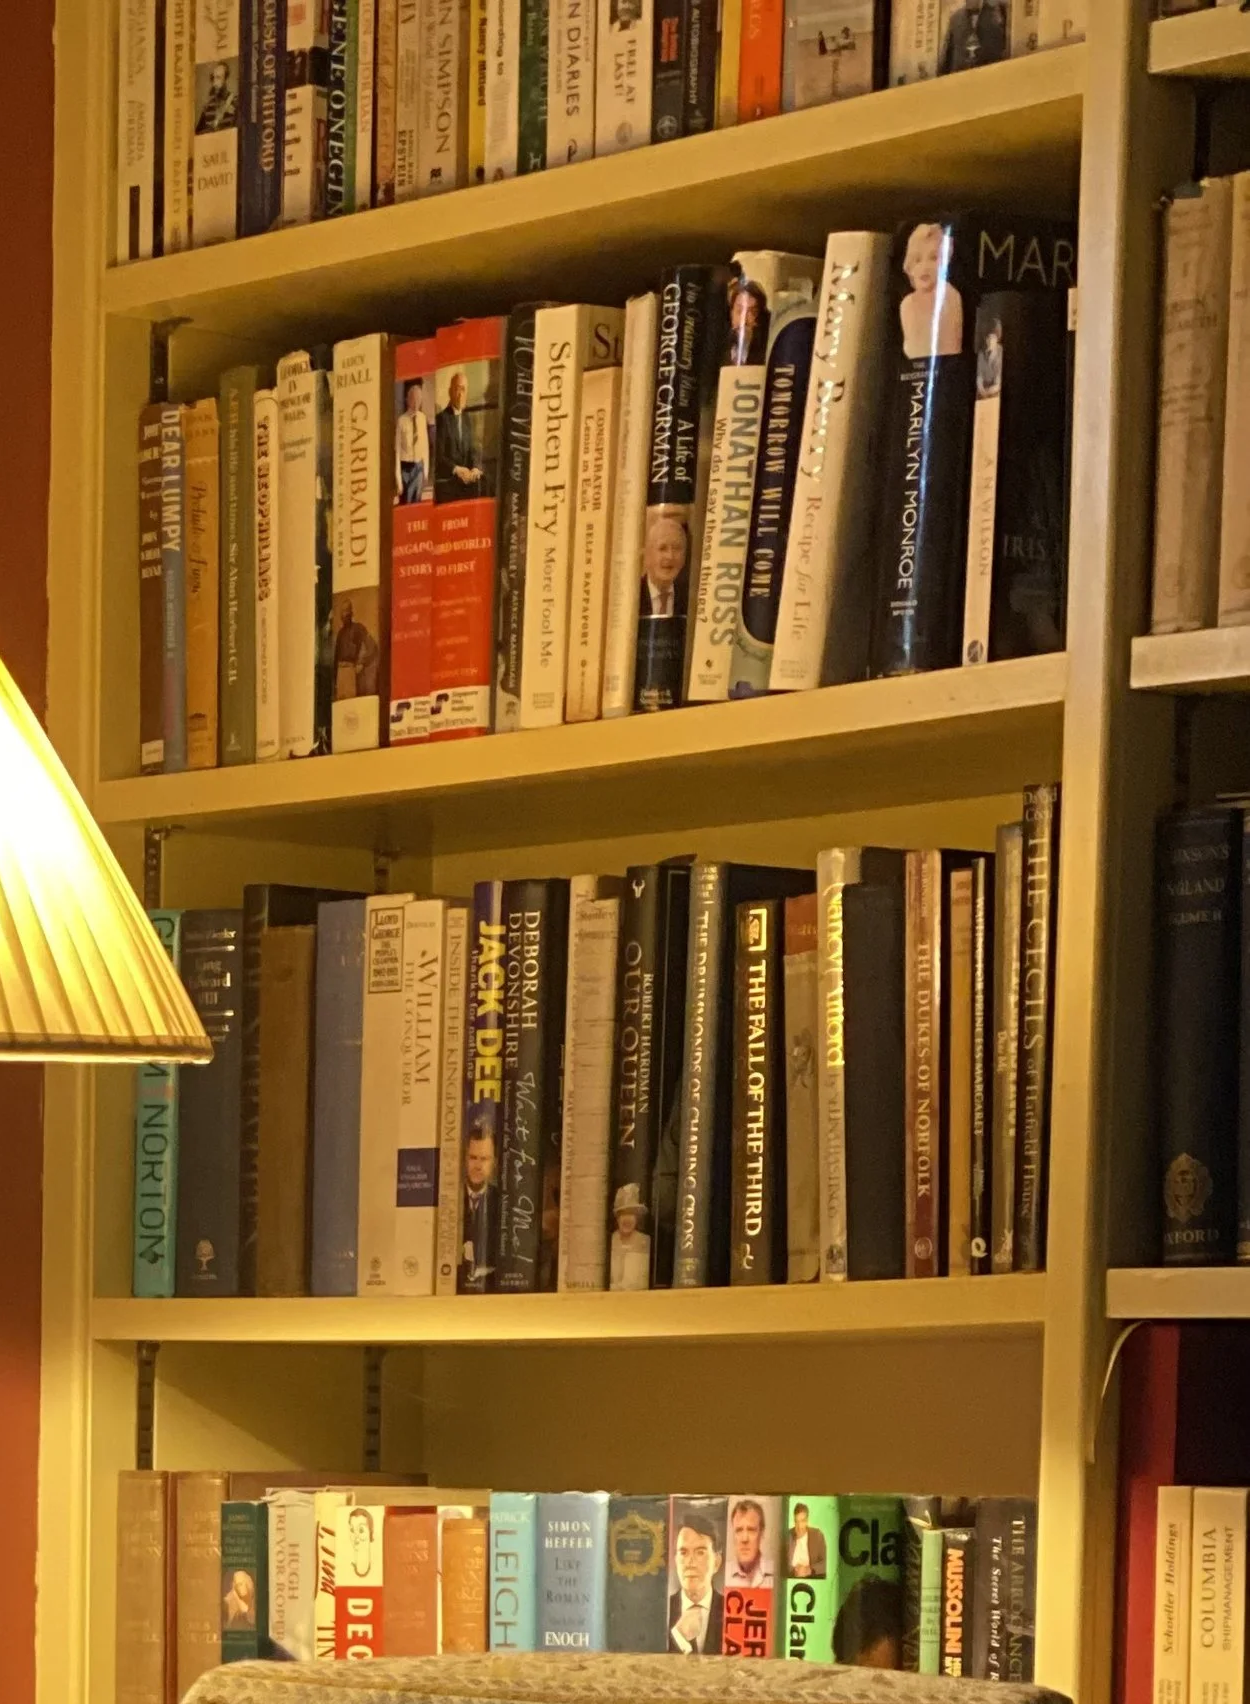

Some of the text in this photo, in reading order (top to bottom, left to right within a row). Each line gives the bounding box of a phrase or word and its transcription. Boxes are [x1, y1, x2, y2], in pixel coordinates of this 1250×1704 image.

[174, 44, 184, 98] RAJAH
[566, 27, 581, 117] DIARIES
[625, 39, 637, 104] FREE AT
[688, 8, 701, 104] AUTOBIOGRAPHY
[261, 54, 276, 171] OF MITFORD
[436, 33, 453, 152] SIMPSON
[198, 173, 234, 191] DAVID
[203, 152, 229, 168] SAUL
[327, 89, 345, 214] ONEGIN
[397, 130, 407, 186] EPSTEIN
[816, 261, 859, 367] Mary
[337, 368, 373, 389] RIALL
[650, 283, 681, 484] GEORGE CARMAN
[583, 415, 594, 455] Lenin
[592, 408, 606, 511] CONSPIRATOR
[675, 419, 693, 483] A Life of
[712, 416, 728, 448] Why
[712, 453, 722, 472] do
[720, 378, 762, 548] JONATHAN
[801, 378, 845, 482] Berry
[161, 409, 181, 551] DEAR LUMPY
[350, 401, 369, 568] GARIBALDI
[511, 493, 520, 526] MARY
[534, 341, 571, 668] Stephen Fry More Fool Me
[581, 478, 592, 512] Exile
[705, 488, 719, 514] say
[749, 363, 796, 598] TOMORROW WILL COME
[897, 381, 925, 590] MARILYN MONROE
[229, 540, 239, 560] Sir
[406, 520, 429, 533] THE
[442, 517, 469, 531] FROM
[453, 537, 492, 551] WORLD
[510, 533, 519, 579] WESLEY
[585, 523, 594, 564] HELEN
[702, 520, 717, 559] these
[797, 496, 823, 565] Recipe
[978, 496, 991, 577] WILSON
[229, 564, 239, 598] Alan
[448, 560, 476, 575] FIRST
[696, 565, 714, 623] things?
[710, 560, 743, 645] ROSS
[794, 566, 813, 595] for
[229, 599, 239, 652] Herbert
[581, 572, 593, 647] RAPPAPORT
[791, 600, 810, 640] Life
[1026, 836, 1048, 908] THE
[694, 911, 709, 947] THE
[448, 934, 462, 997] INSIDE
[505, 912, 523, 1069] DEVONSHIRE
[522, 911, 541, 1030] DEBORAH
[1023, 920, 1047, 1050] CECILS
[401, 961, 414, 1106] THE CONQUEROR
[414, 957, 438, 1084] WILLIAM
[446, 1003, 460, 1041] THE
[467, 949, 479, 1079] thanks for nothing
[474, 920, 506, 1104] JACK DEE
[619, 942, 642, 1150] OUR QUEEN
[638, 974, 654, 1113] ROBERT HARDMAN
[689, 952, 708, 1074] DRUMMONDS
[444, 1047, 459, 1143] KINGDOM
[744, 960, 767, 1237] THE FALL OF THE THIRD
[915, 941, 931, 1197] THE DUKES OF NORFOLK
[973, 1063, 984, 1137] MARGARET
[1025, 1059, 1038, 1077] of
[684, 1107, 700, 1189] CHARING
[1022, 1085, 1039, 1156] Hatfield
[138, 1104, 169, 1260] NORTON
[509, 1072, 537, 1263] Wait for Me!
[1020, 1165, 1039, 1217] House
[500, 1194, 510, 1229] Mitford
[680, 1194, 696, 1250] CROSS
[544, 1537, 594, 1549] HEFFER
[548, 1521, 591, 1533] SIMON
[838, 1517, 900, 1567] Cla
[274, 1505, 287, 1641] TREVOR ROPER
[288, 1543, 299, 1600] HUGH
[495, 1529, 519, 1648] LEIGH
[546, 1592, 591, 1604] ROMAN
[554, 1557, 581, 1571] LIKE
[557, 1576, 578, 1587] THE
[1009, 1517, 1025, 1681] THE ARROGANCE
[1163, 1523, 1177, 1654] Schoeller Holdings
[1201, 1527, 1217, 1648] COLUMBIA
[1222, 1526, 1235, 1652] SHIPMANAGEMENT
[724, 1590, 744, 1657] CLA
[743, 1599, 767, 1658] JER
[945, 1548, 964, 1654] MUSSOLINI
[988, 1536, 1002, 1668] The Secret World of
[545, 1631, 590, 1647] ENOCH
